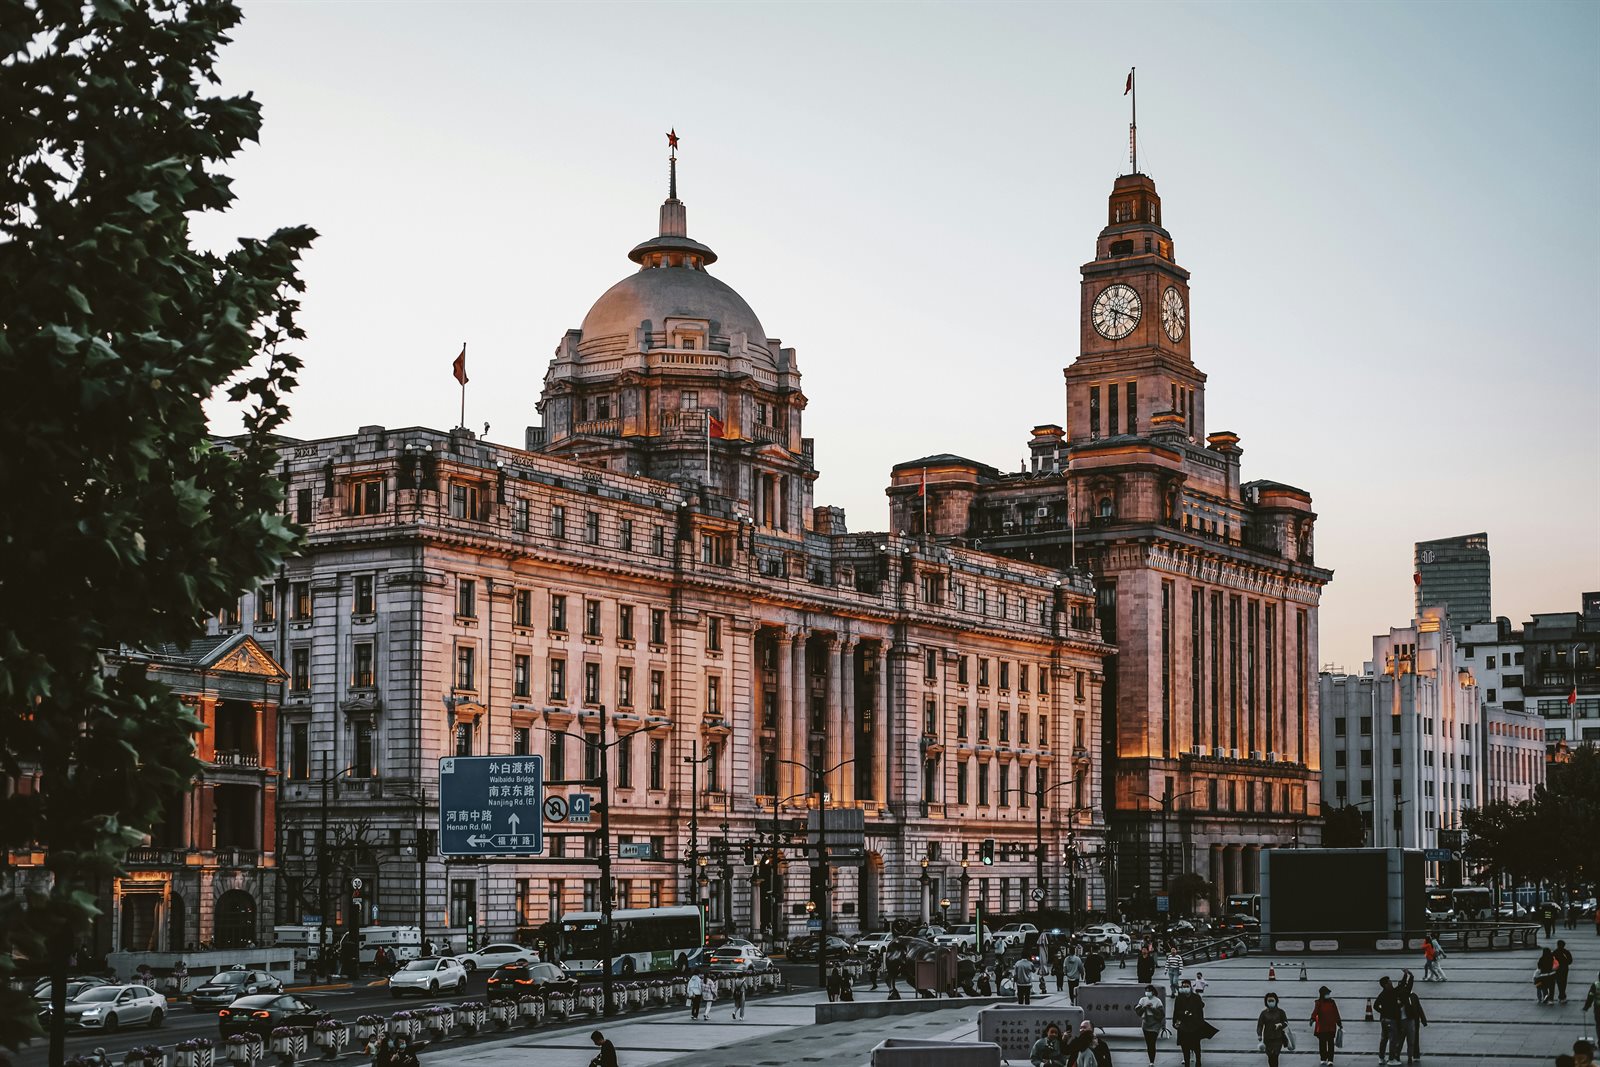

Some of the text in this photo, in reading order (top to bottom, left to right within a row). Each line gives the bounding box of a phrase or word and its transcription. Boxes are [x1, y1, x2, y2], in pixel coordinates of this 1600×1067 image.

[489, 761, 535, 774] 外白渡桥
[516, 775, 534, 784] Bridge
[489, 785, 535, 797] 南京东路
[488, 799, 513, 807] Nanjing
[446, 810, 492, 822] 河南中路
[498, 836, 531, 845] 福州路
